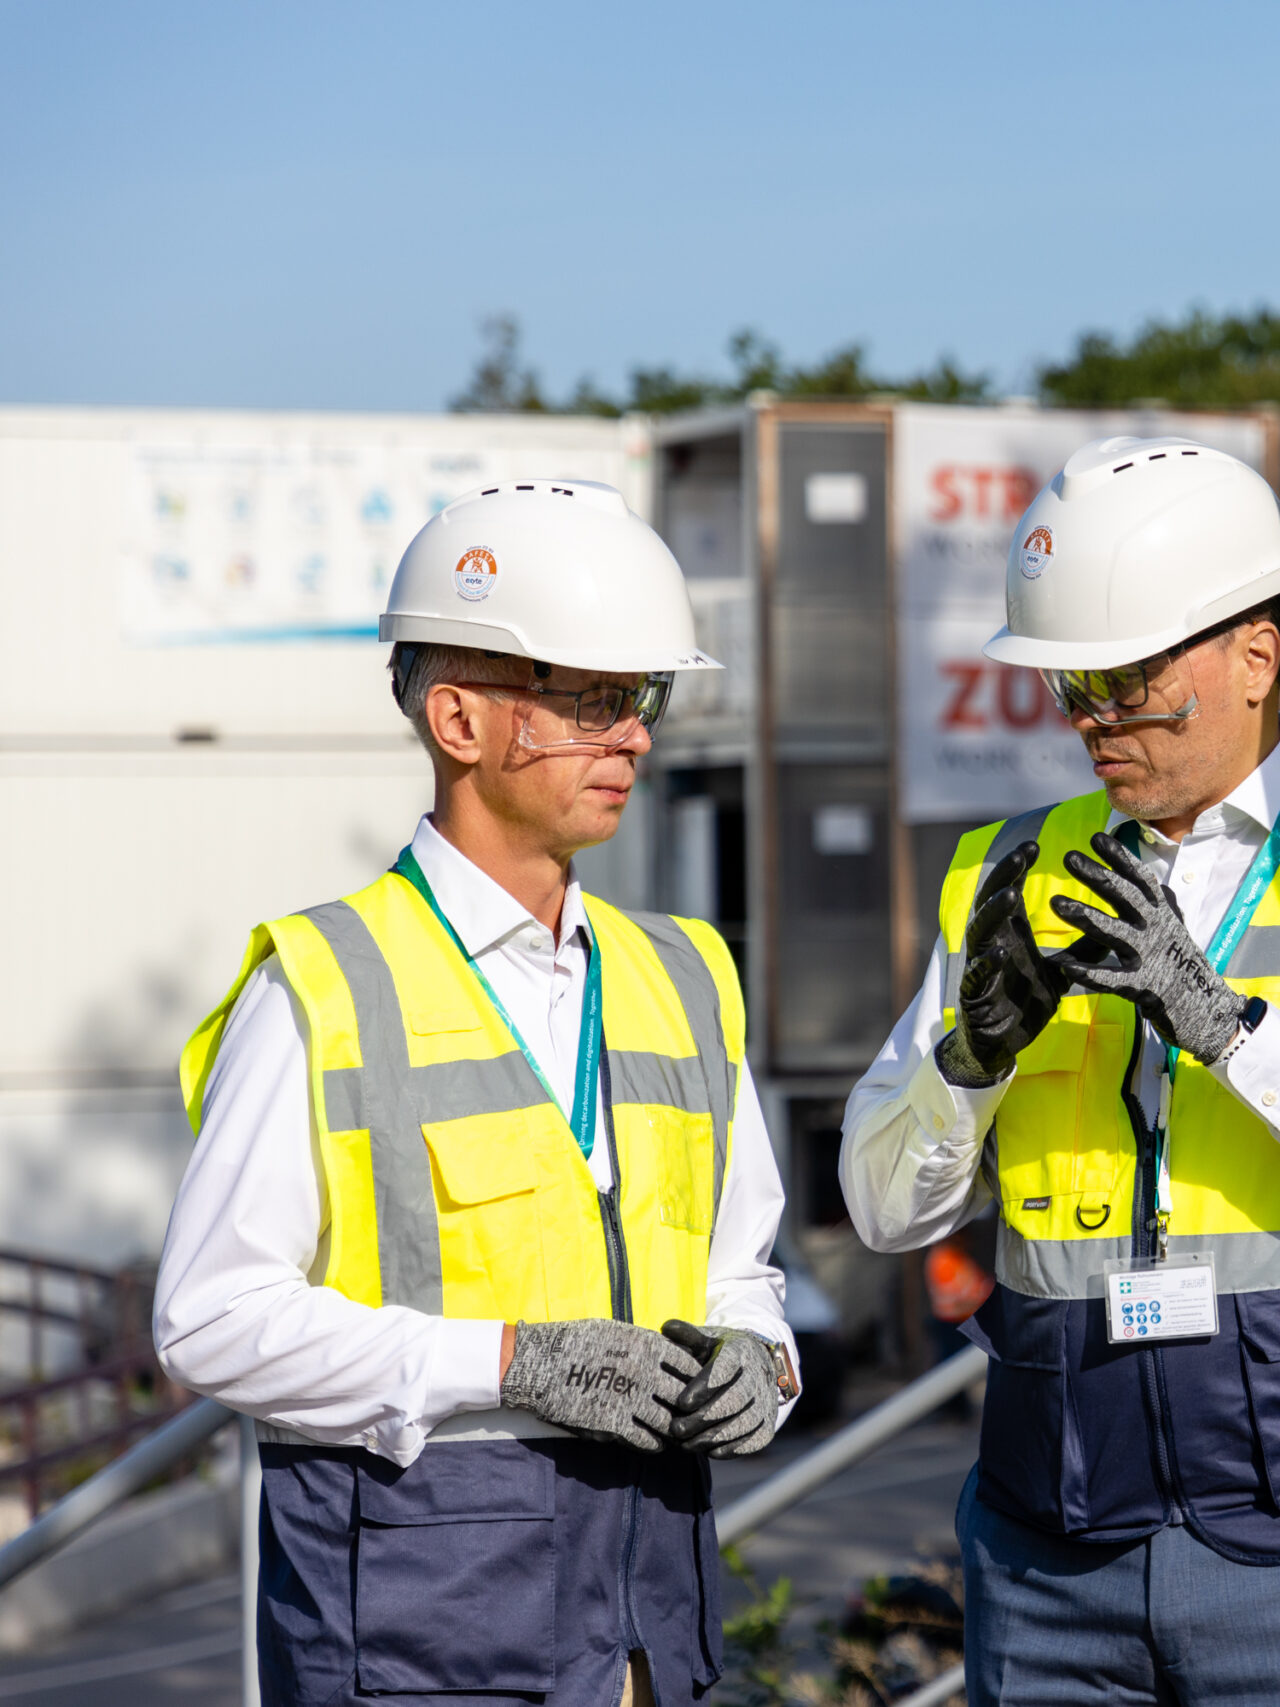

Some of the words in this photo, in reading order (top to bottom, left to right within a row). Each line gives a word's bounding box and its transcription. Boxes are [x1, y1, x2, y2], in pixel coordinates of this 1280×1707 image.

[929, 464, 1040, 522] STR
[463, 549, 494, 562] SAFETY
[1166, 941, 1215, 998] HyFlex
[1215, 947, 1225, 962] and
[582, 1072, 591, 1122] decarbonization
[578, 1123, 589, 1146] Driving
[565, 1364, 635, 1399] HyFlex
